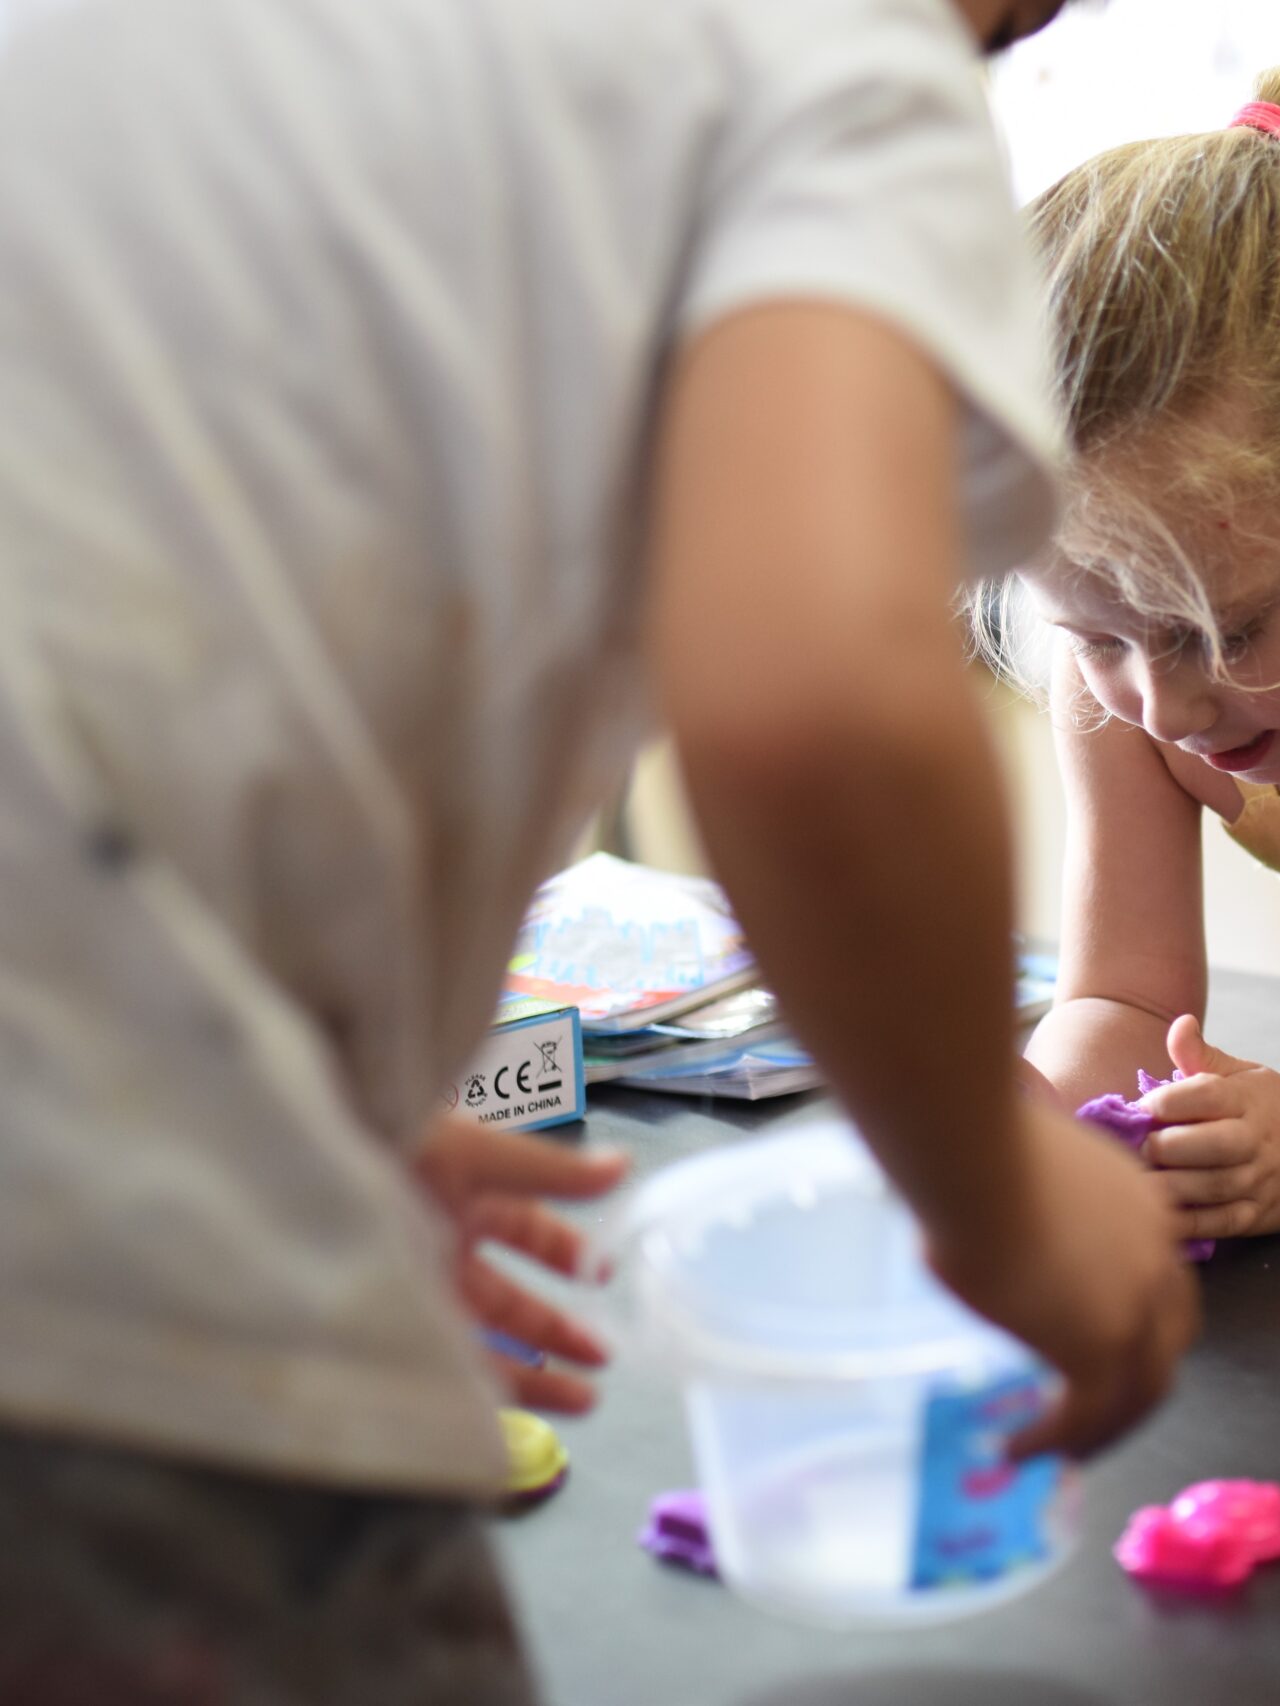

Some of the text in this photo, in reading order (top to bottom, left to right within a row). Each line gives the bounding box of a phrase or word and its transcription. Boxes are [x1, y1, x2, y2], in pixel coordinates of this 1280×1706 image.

[494, 1061, 532, 1099] CE
[478, 1096, 562, 1124] MADE IN CHINA
